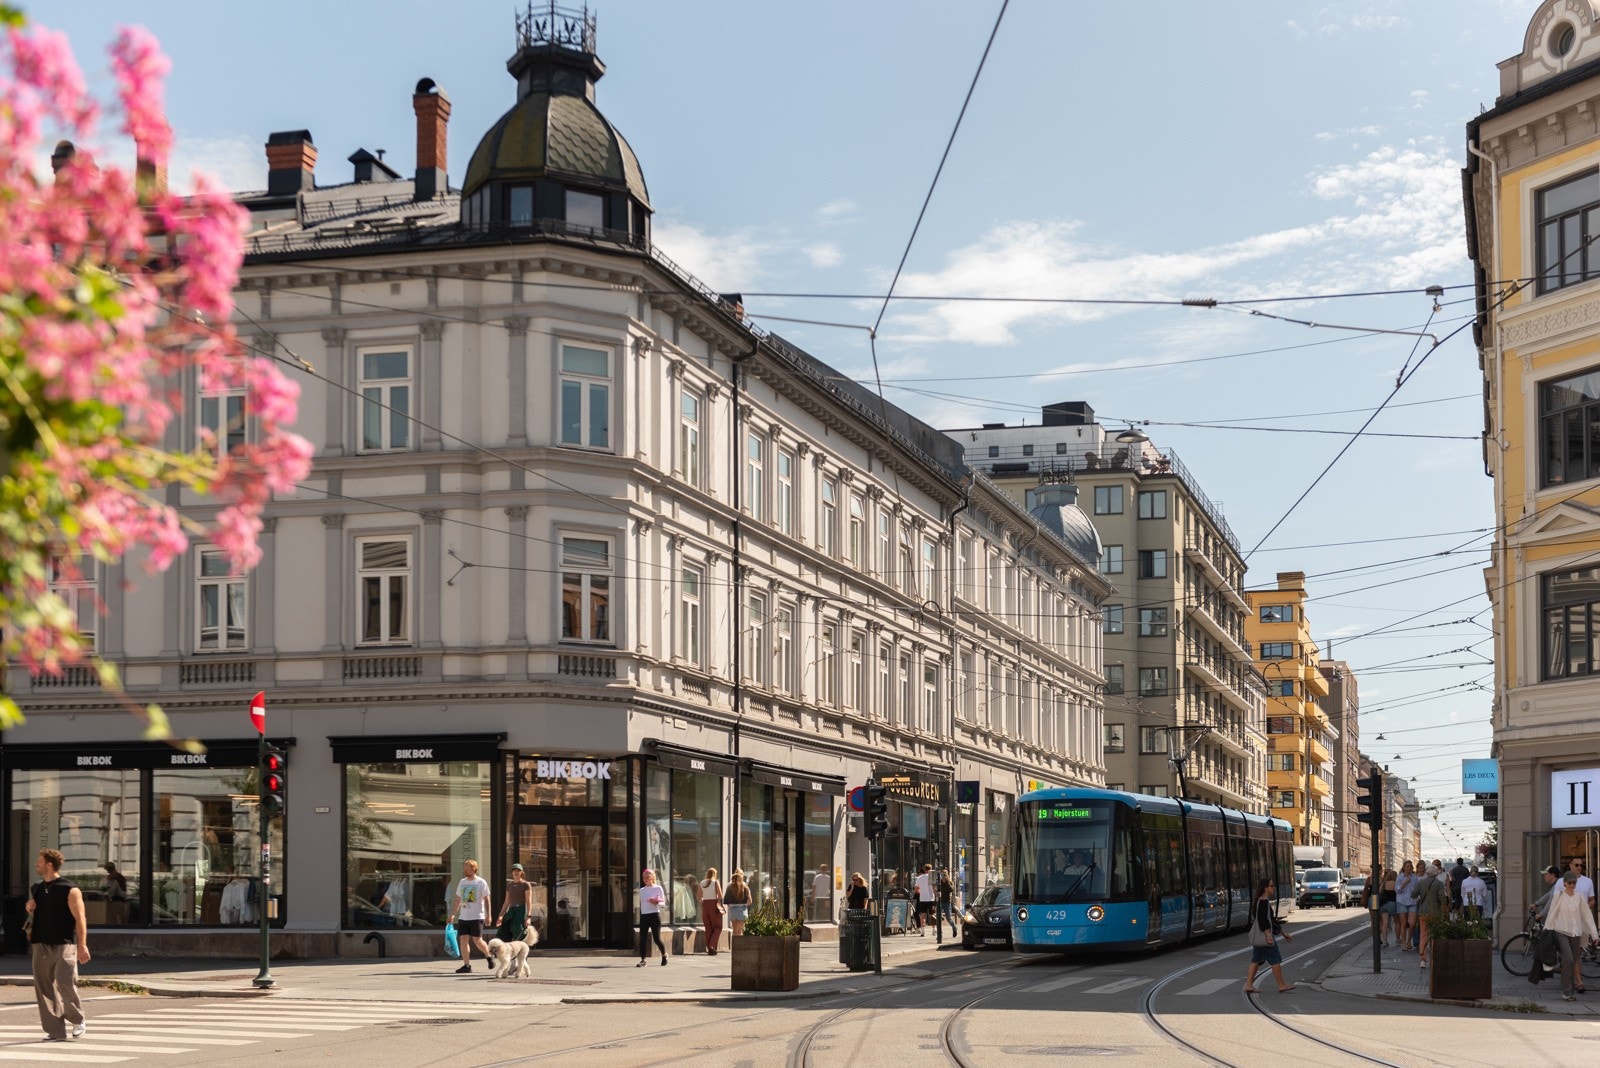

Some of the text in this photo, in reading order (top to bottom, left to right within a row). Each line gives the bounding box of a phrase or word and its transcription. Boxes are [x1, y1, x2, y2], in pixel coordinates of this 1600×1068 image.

[1566, 780, 1592, 816] II
[1038, 809, 1089, 819] 19 Majorstuen
[1046, 910, 1066, 920] 429
